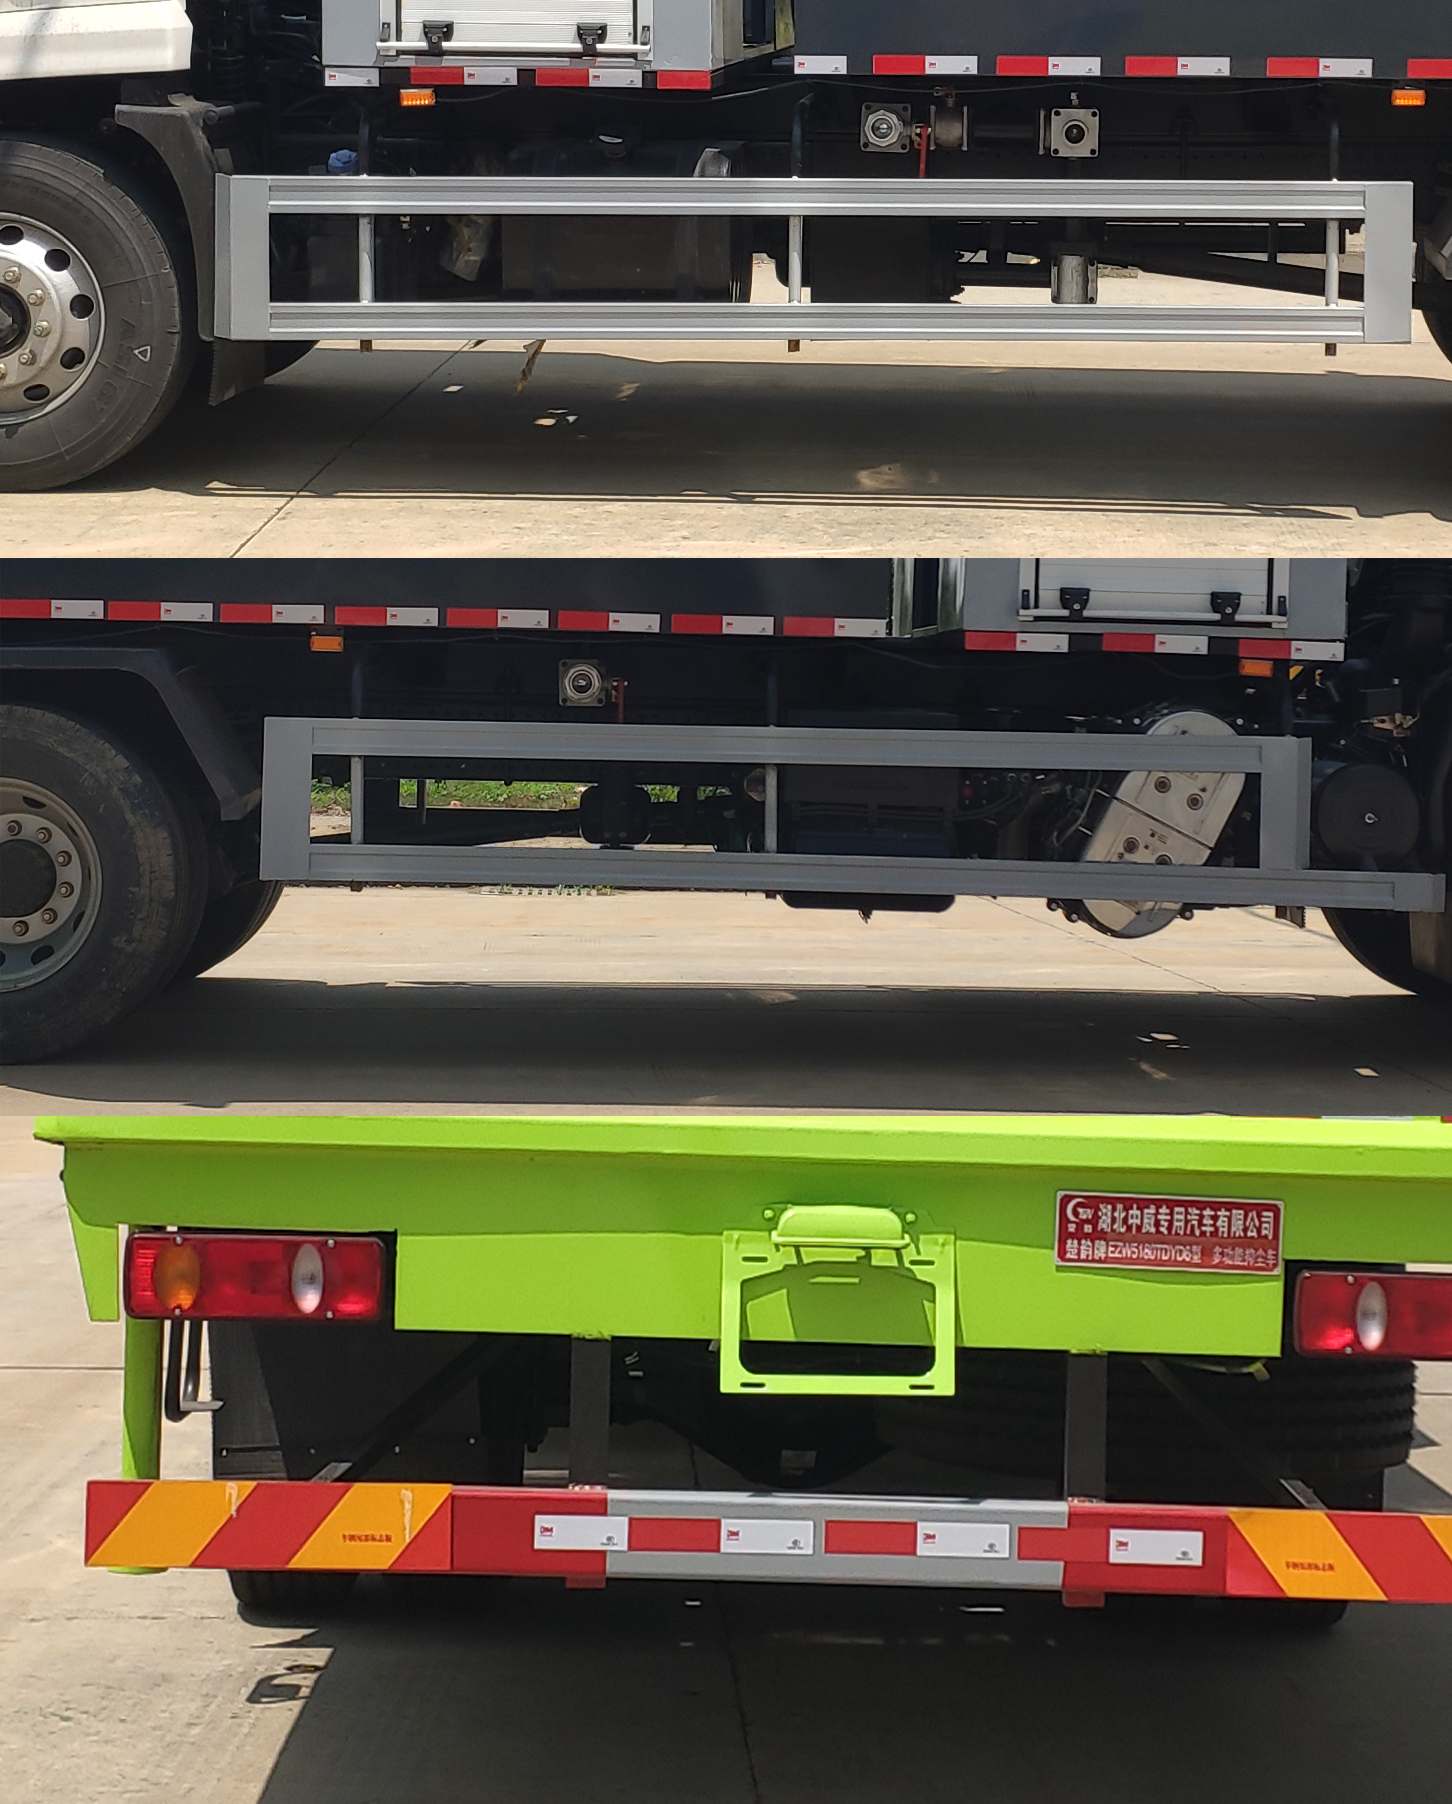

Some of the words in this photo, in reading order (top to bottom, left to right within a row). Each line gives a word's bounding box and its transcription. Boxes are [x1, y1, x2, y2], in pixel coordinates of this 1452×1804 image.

[1098, 1204, 1275, 1239] 湖北中威专用汽车有限公司
